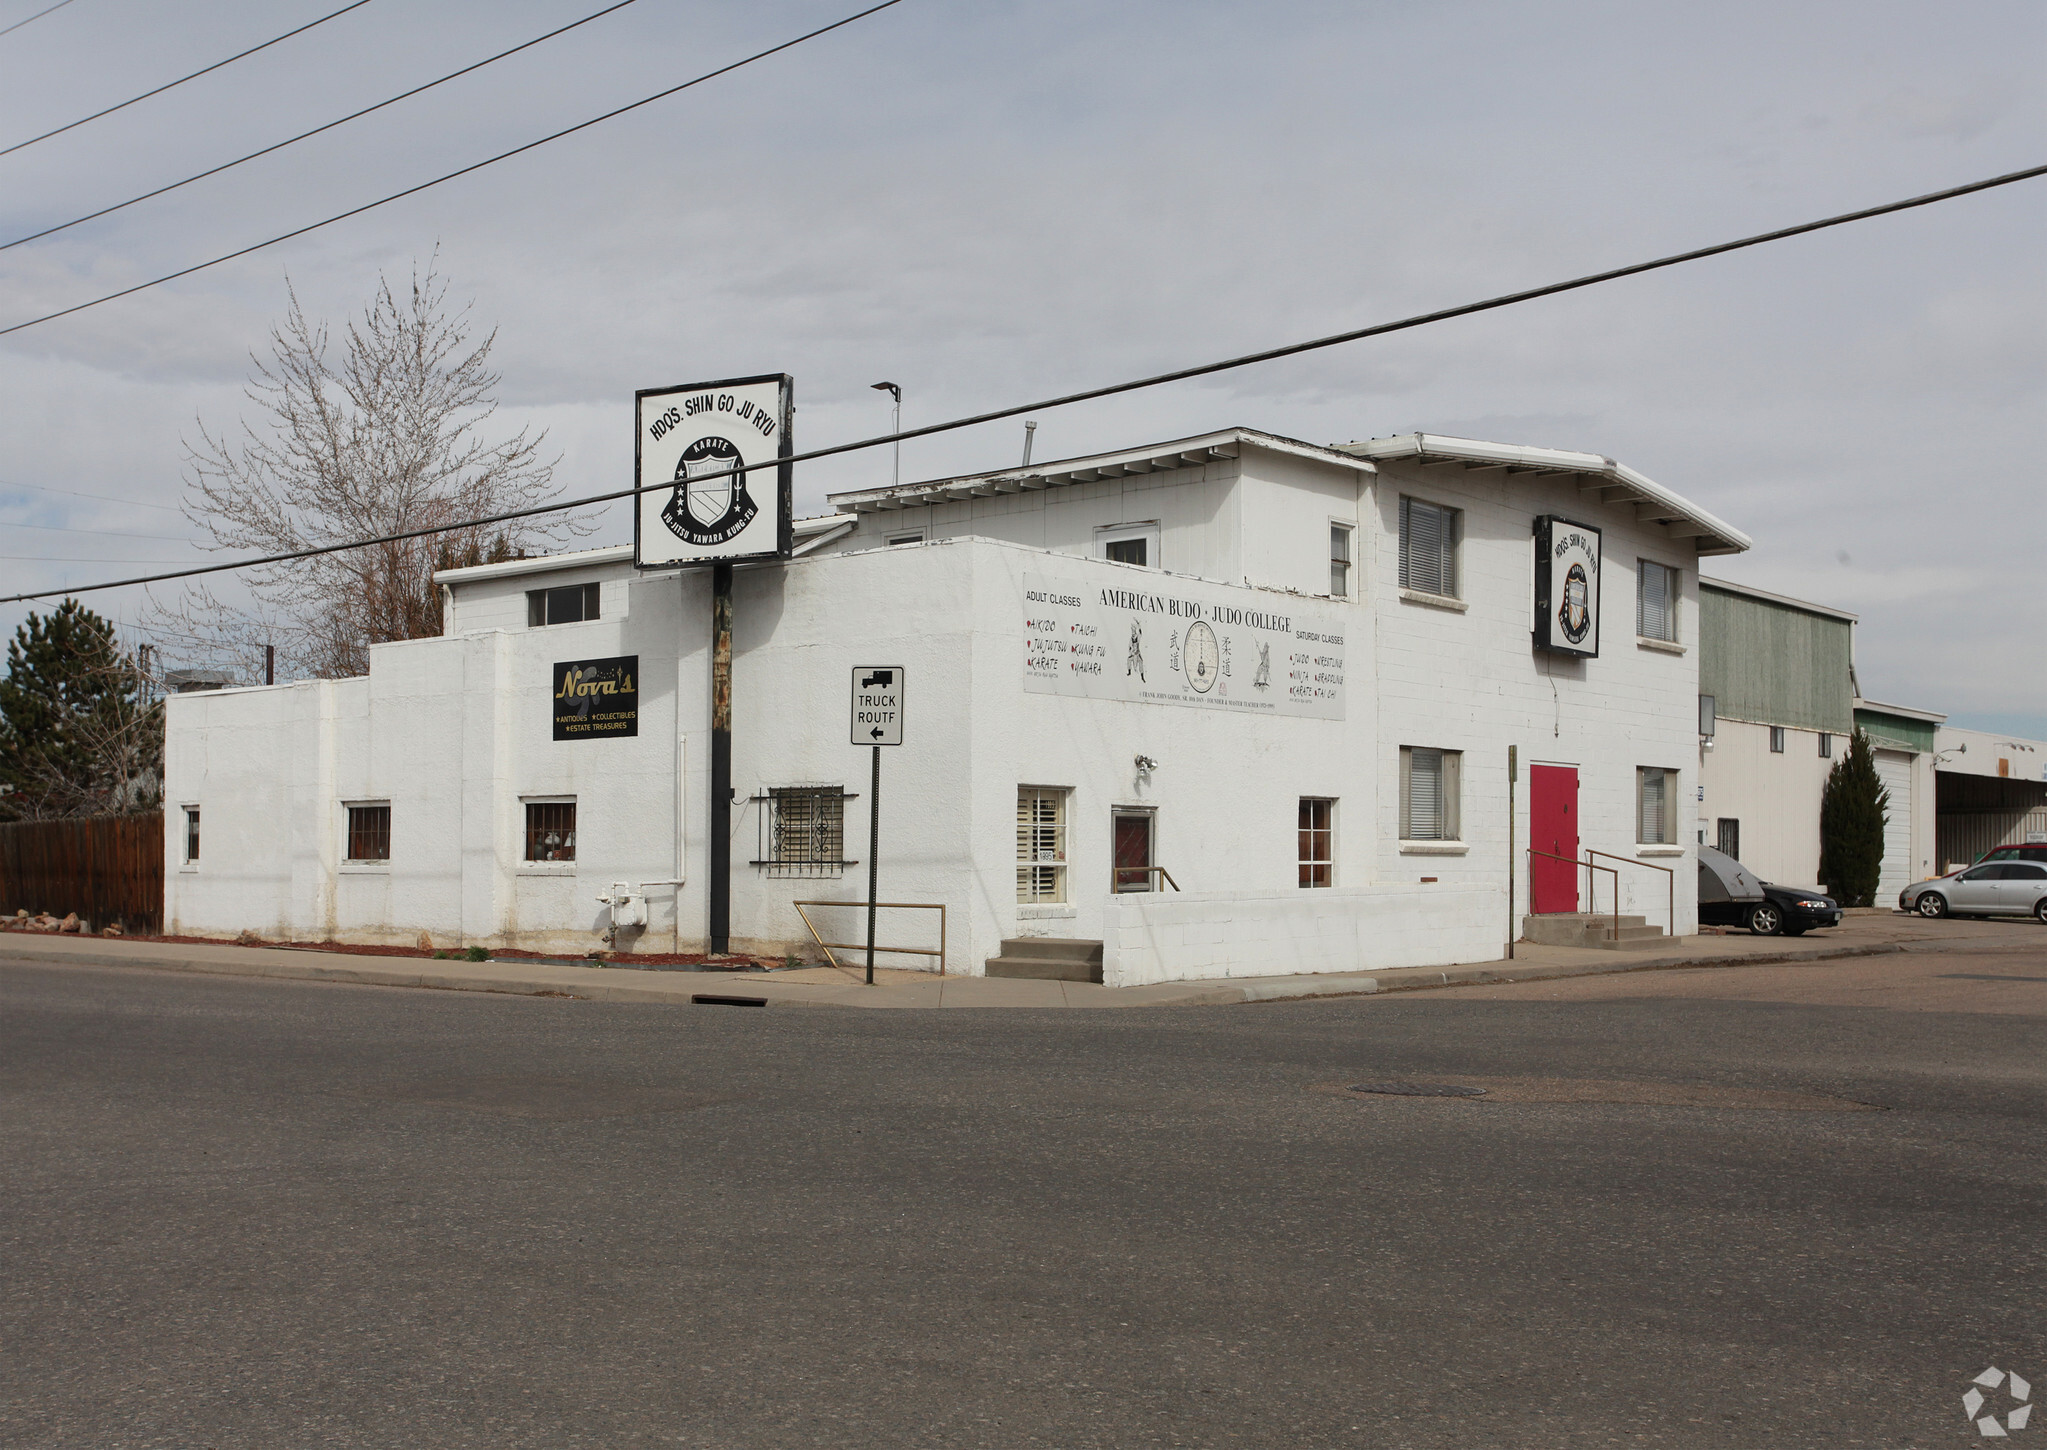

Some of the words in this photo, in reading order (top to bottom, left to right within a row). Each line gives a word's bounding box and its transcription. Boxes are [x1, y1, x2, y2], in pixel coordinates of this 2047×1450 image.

[685, 394, 713, 416] SHIN
[717, 394, 734, 412] GO
[736, 400, 755, 419] JU
[752, 409, 776, 437] RYU
[693, 439, 729, 453] KARATE
[663, 512, 690, 539] JU-JITSU
[693, 532, 723, 544] YAWARA
[726, 508, 755, 538] KUNG-FU
[1026, 590, 1047, 602] ADULT
[1049, 593, 1081, 607] CLASSES
[1099, 588, 1164, 613] AMERICAN
[1169, 598, 1201, 619] BUDO
[1212, 606, 1242, 626] JUDO
[1245, 610, 1291, 633] COLLEGE
[1030, 619, 1056, 633] AIKIDO
[1296, 630, 1320, 642] SATURDAY
[1321, 634, 1344, 645] CLASSES
[1075, 643, 1094, 657] KUNG
[1096, 646, 1106, 657] FU
[1031, 656, 1058, 670] KARATE
[1074, 660, 1102, 677] YAWARA
[556, 668, 636, 699] Nova's
[858, 695, 896, 707] TRUCK
[596, 711, 636, 720] COLLECTIBLES
[570, 723, 591, 732] ESTATE
[593, 721, 627, 731] TREASURES
